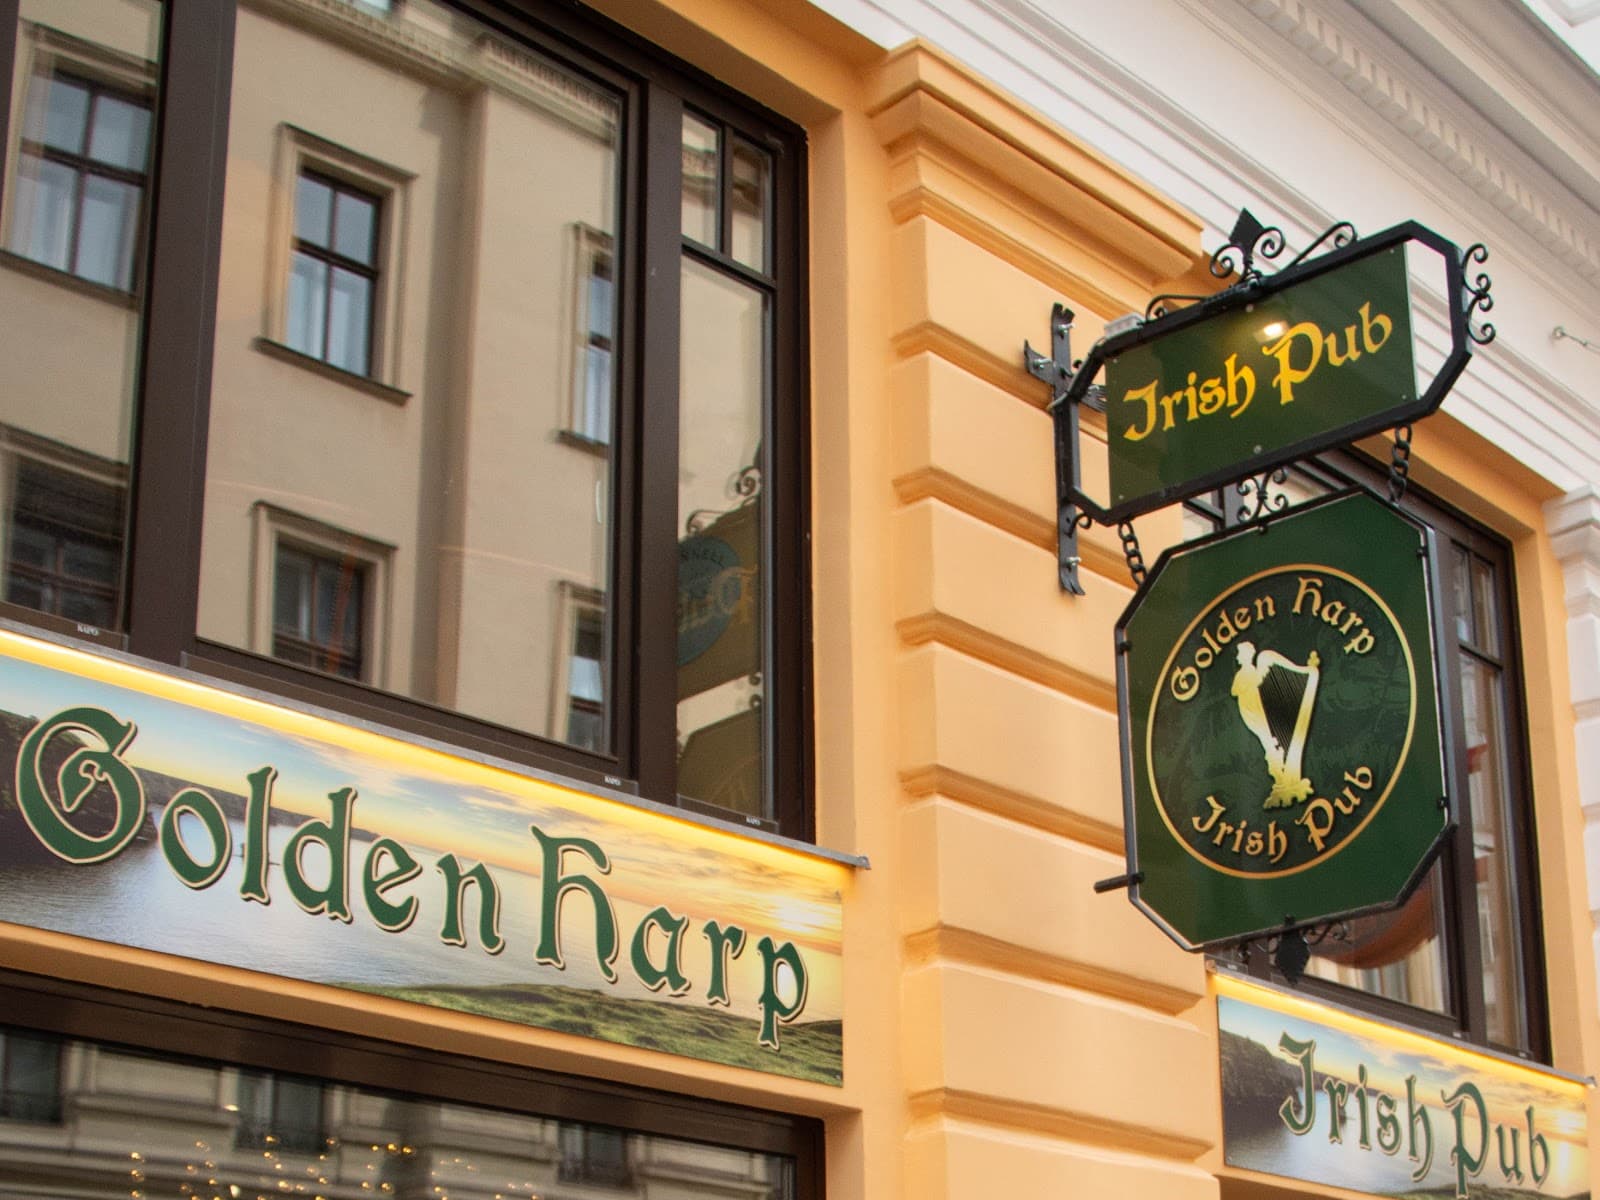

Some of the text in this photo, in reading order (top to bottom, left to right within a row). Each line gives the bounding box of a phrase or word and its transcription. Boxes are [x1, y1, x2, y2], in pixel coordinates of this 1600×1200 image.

[1123, 301, 1393, 442] Irish Pub
[1170, 576, 1375, 703] Golden Harp
[15, 706, 809, 1052] Golden Harp
[1192, 766, 1374, 864] Irish Pub
[1278, 1031, 1550, 1200] Irish Pub
